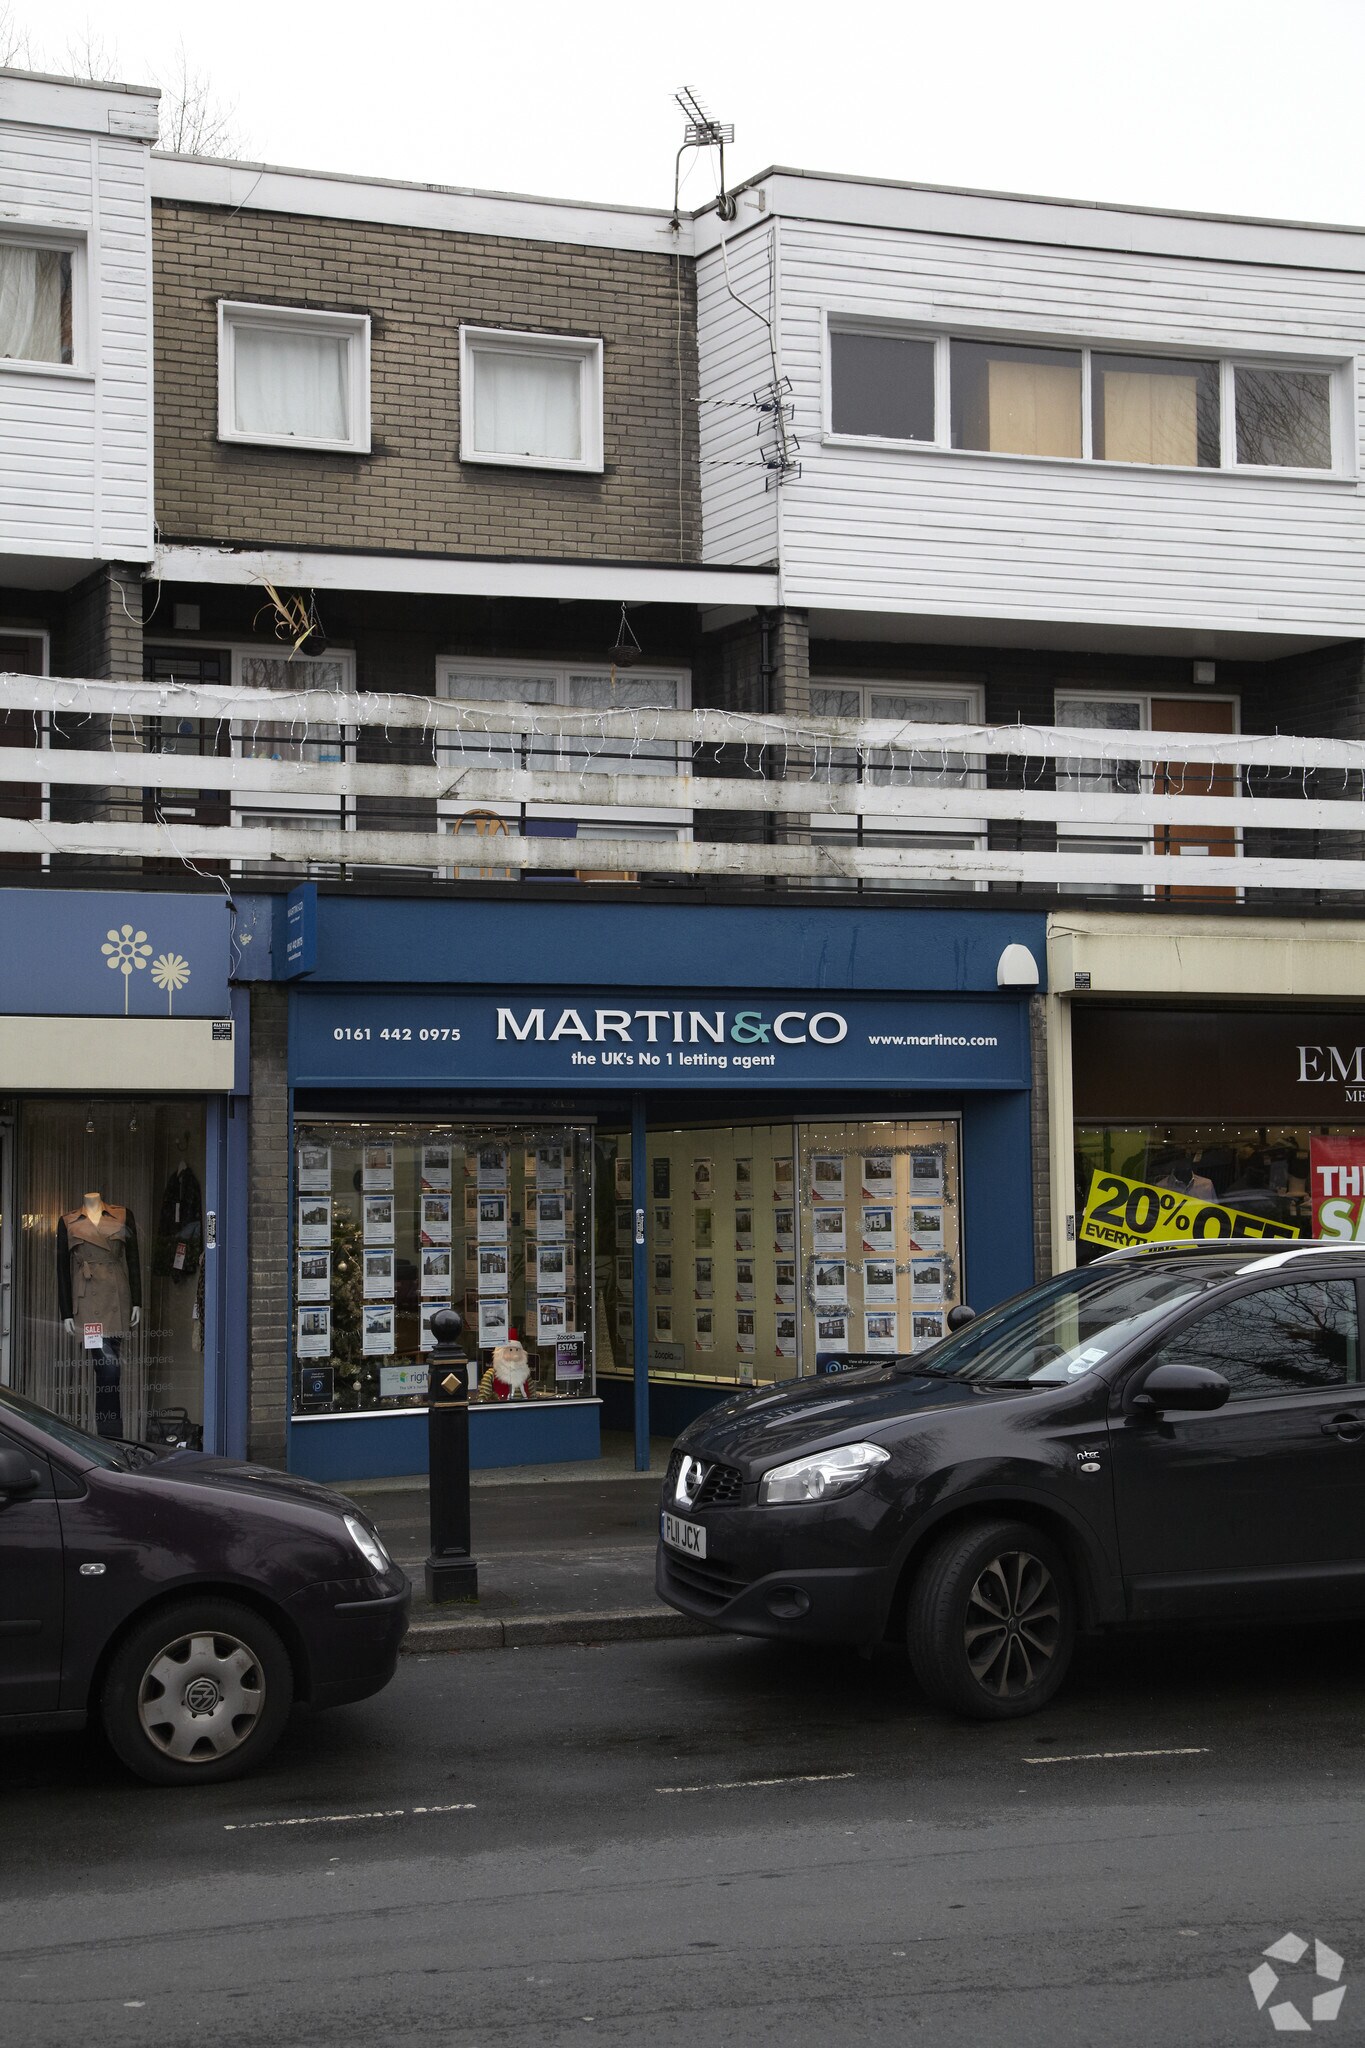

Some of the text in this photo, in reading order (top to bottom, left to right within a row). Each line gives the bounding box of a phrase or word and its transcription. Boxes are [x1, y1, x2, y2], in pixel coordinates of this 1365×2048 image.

[333, 1028, 461, 1041] 0161 442 0975
[496, 1007, 848, 1044] MARTIN&CO
[868, 1033, 998, 1047] www.martinco.com
[571, 1051, 776, 1069] the UK's No 1 letting agent
[1316, 1165, 1365, 1196] TH
[1088, 1177, 1191, 1234] 20%
[85, 1325, 101, 1335] SALE
[557, 1343, 578, 1351] ESTAS
[681, 1524, 701, 1552] JCX
